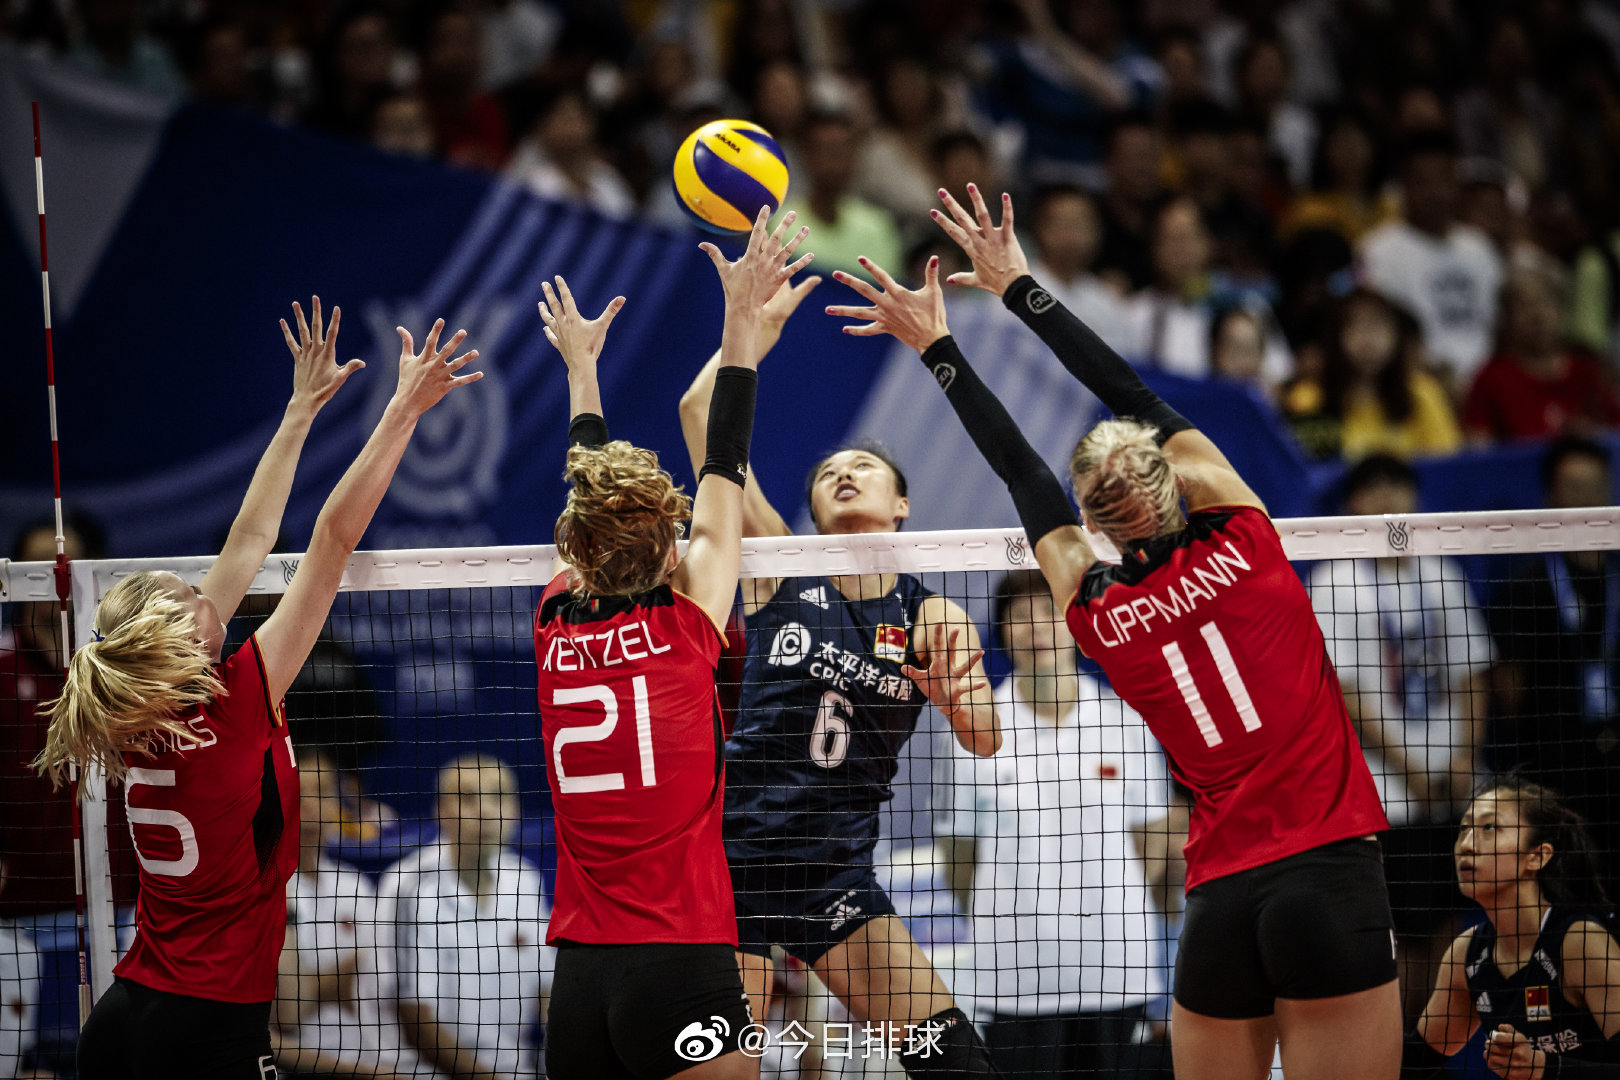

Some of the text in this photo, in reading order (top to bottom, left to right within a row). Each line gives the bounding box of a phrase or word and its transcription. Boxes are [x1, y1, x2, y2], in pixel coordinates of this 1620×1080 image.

[1093, 540, 1251, 648] LIPPMANN
[809, 662, 852, 692] CPIC
[809, 689, 855, 769] 6
[1161, 620, 1262, 748] 11
[552, 675, 657, 794] 21
[124, 767, 200, 877] 6
